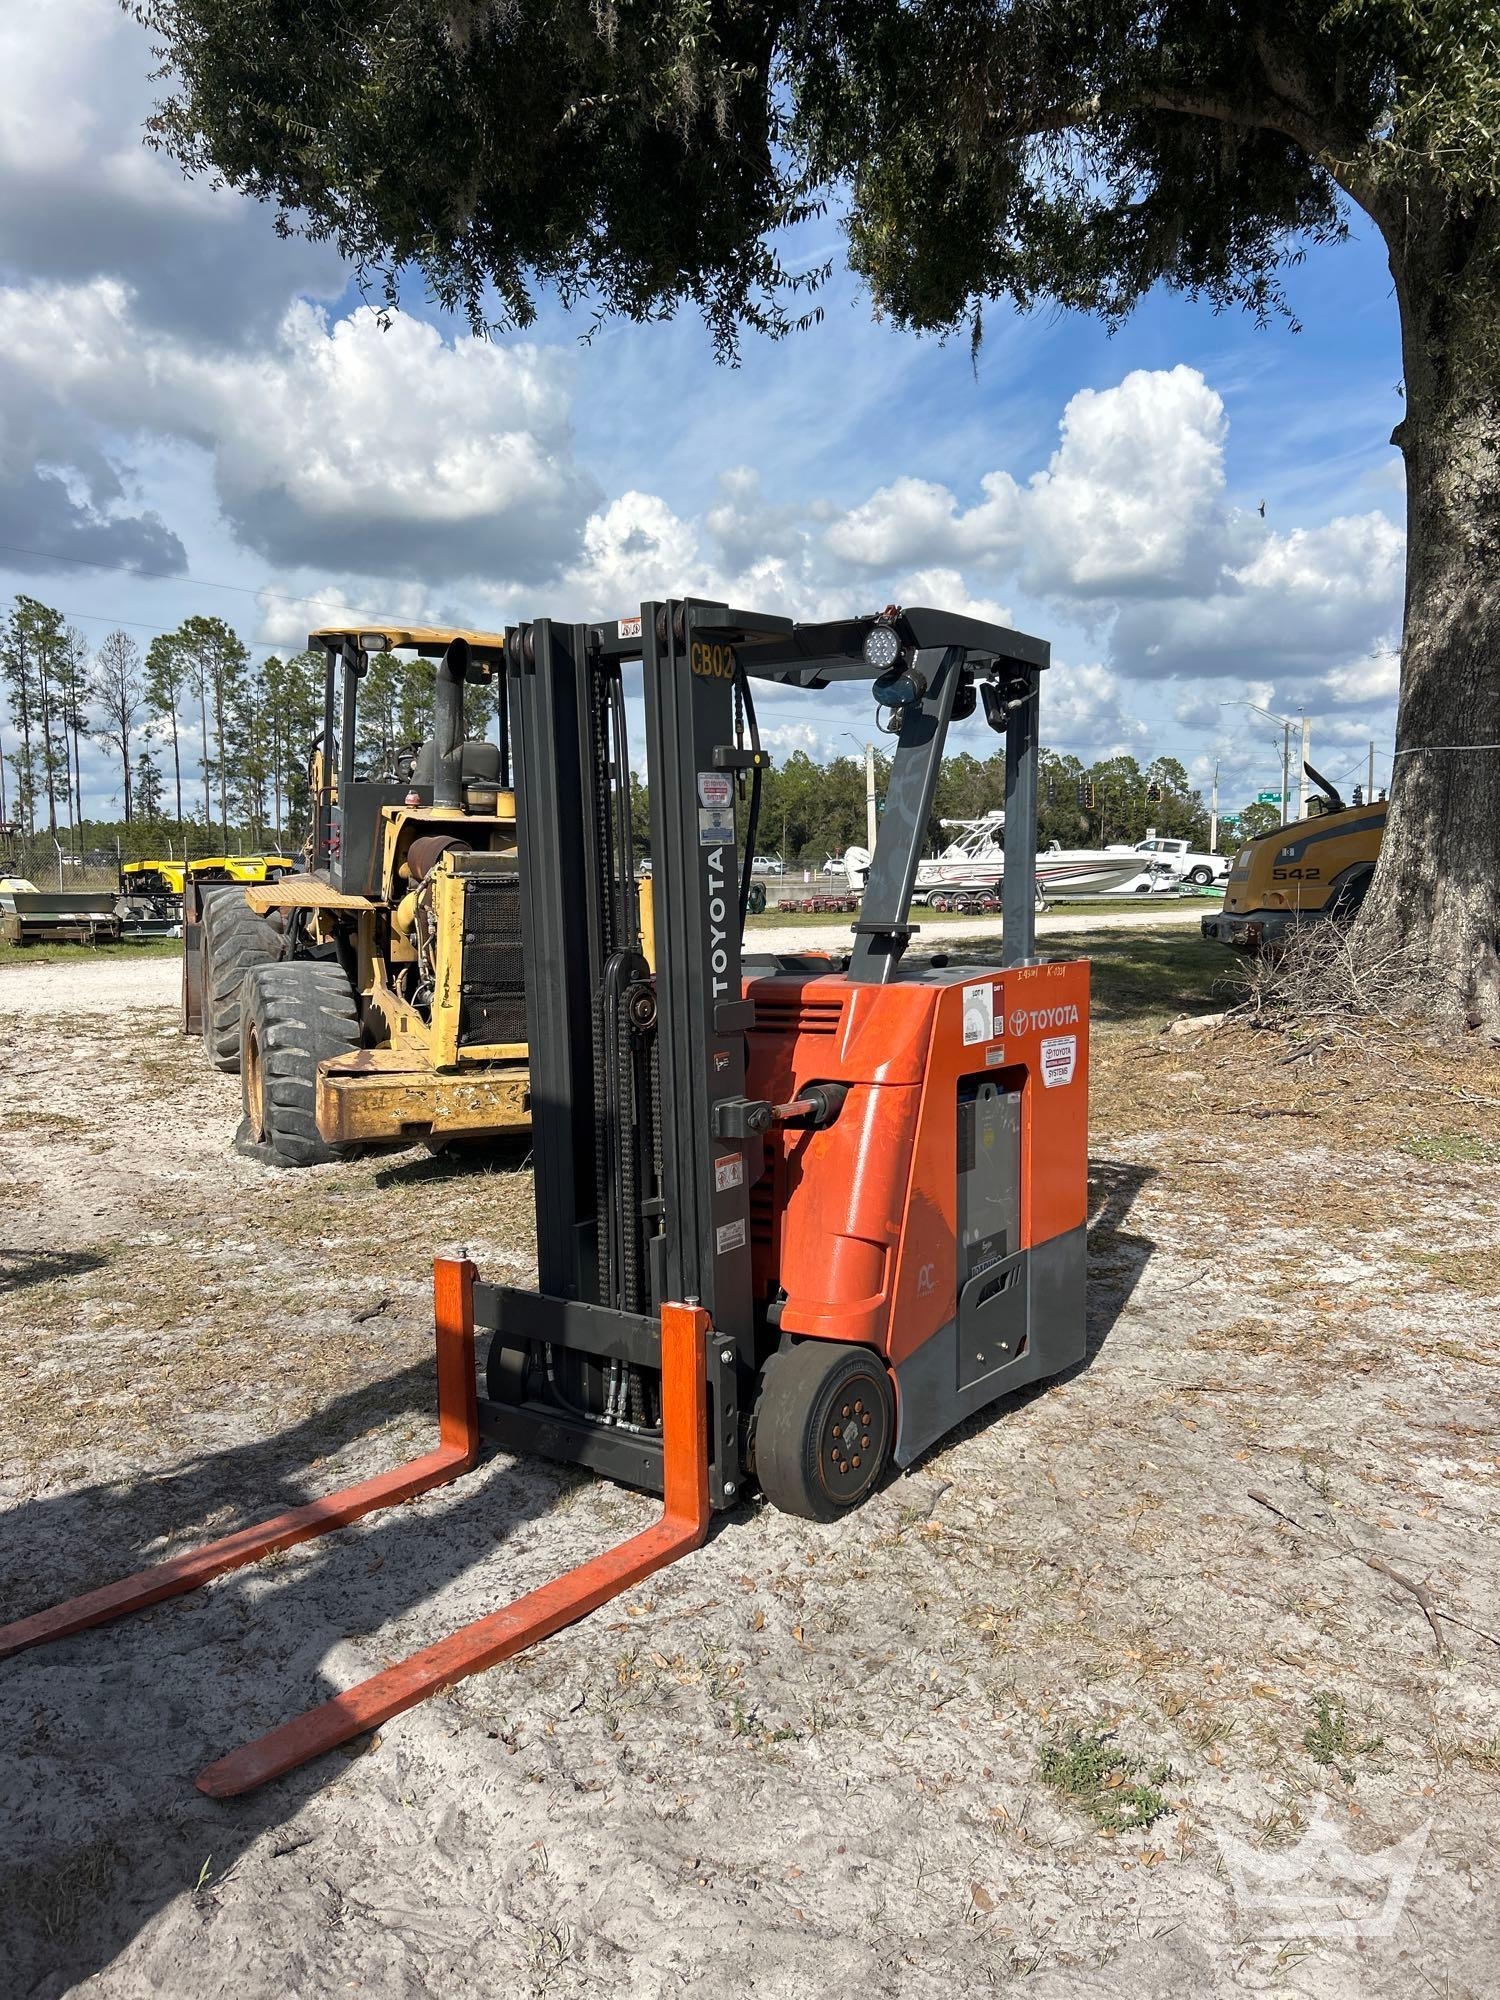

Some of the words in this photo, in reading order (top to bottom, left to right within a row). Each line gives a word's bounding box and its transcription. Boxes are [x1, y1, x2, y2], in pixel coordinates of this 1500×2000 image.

[1273, 868, 1320, 880] 542
[707, 846, 728, 999] TOYOTA
[1030, 1004, 1078, 1031] TOYOTA
[1053, 1046, 1071, 1057] TOYOTA
